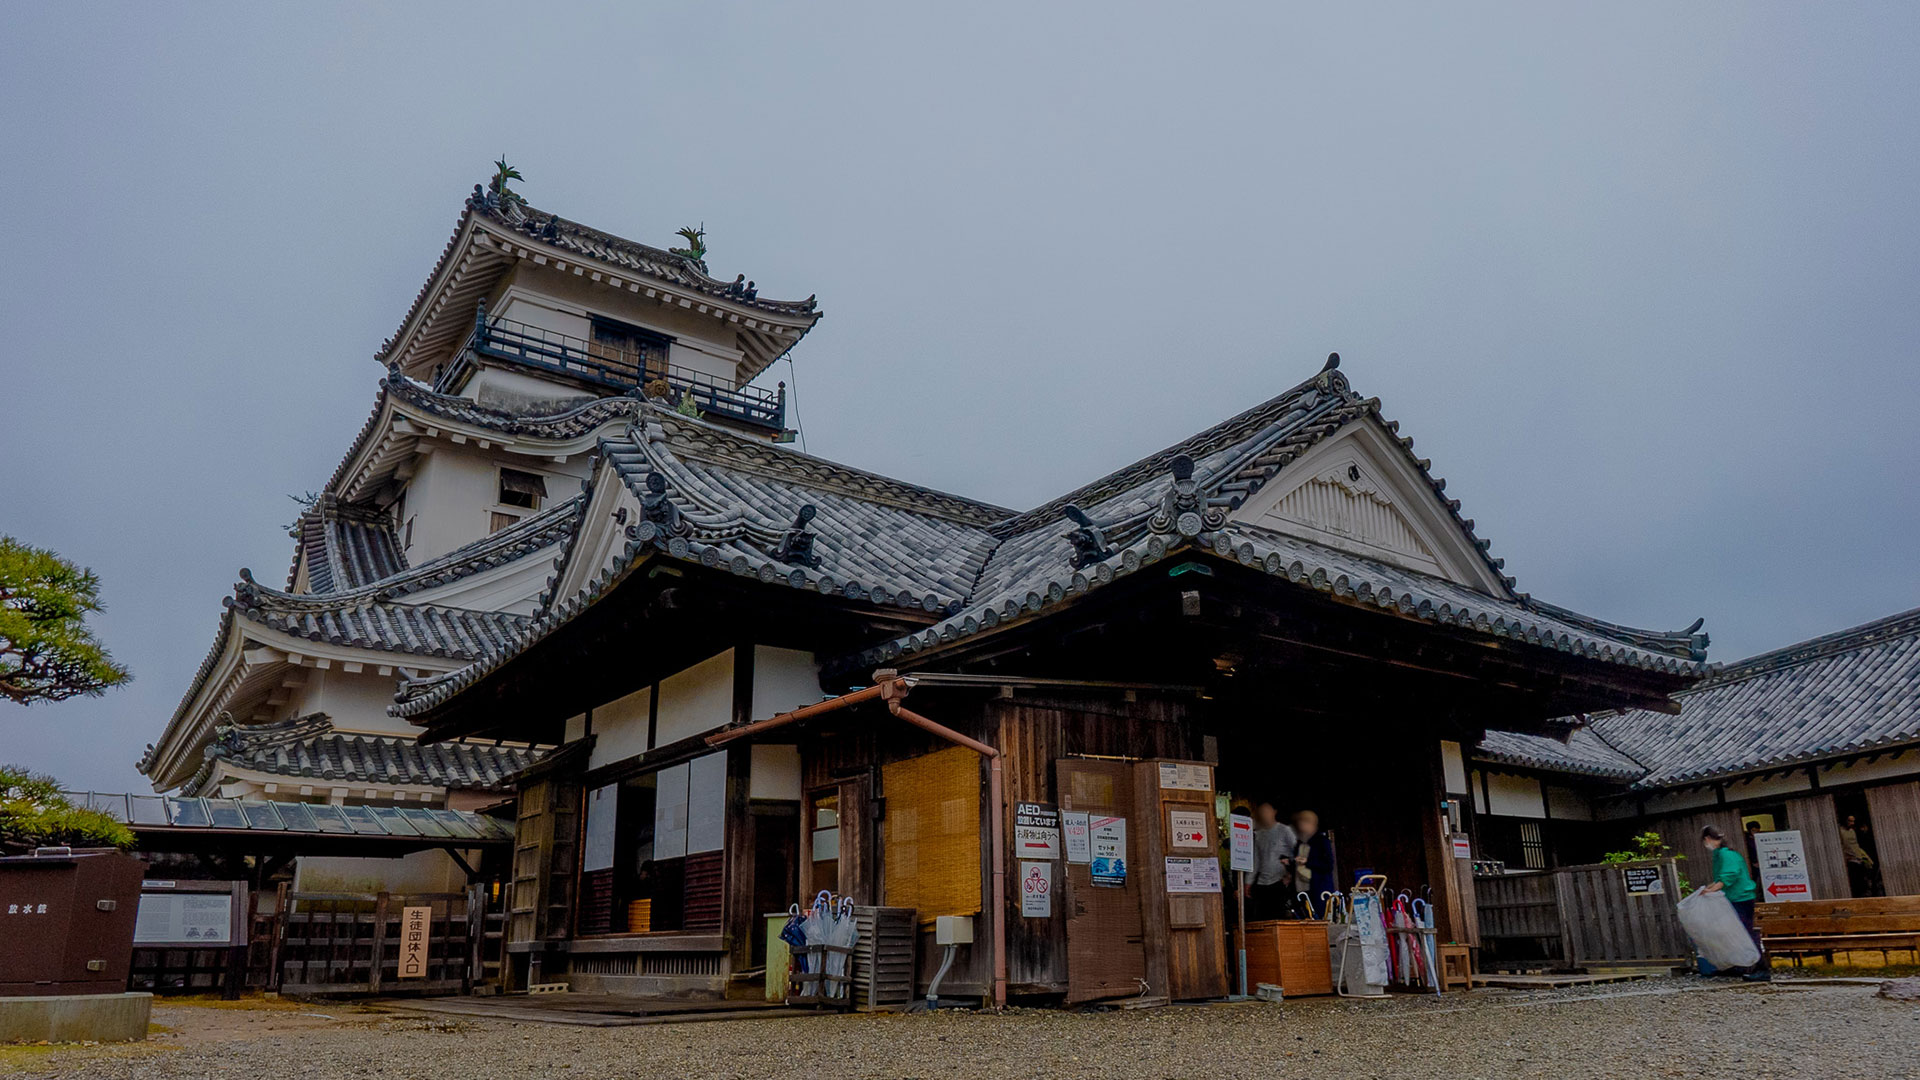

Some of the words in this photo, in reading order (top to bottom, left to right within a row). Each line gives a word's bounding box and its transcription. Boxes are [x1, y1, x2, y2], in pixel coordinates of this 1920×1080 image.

[1017, 804, 1040, 815] AED
[405, 910, 423, 974] 生徒団体入口
